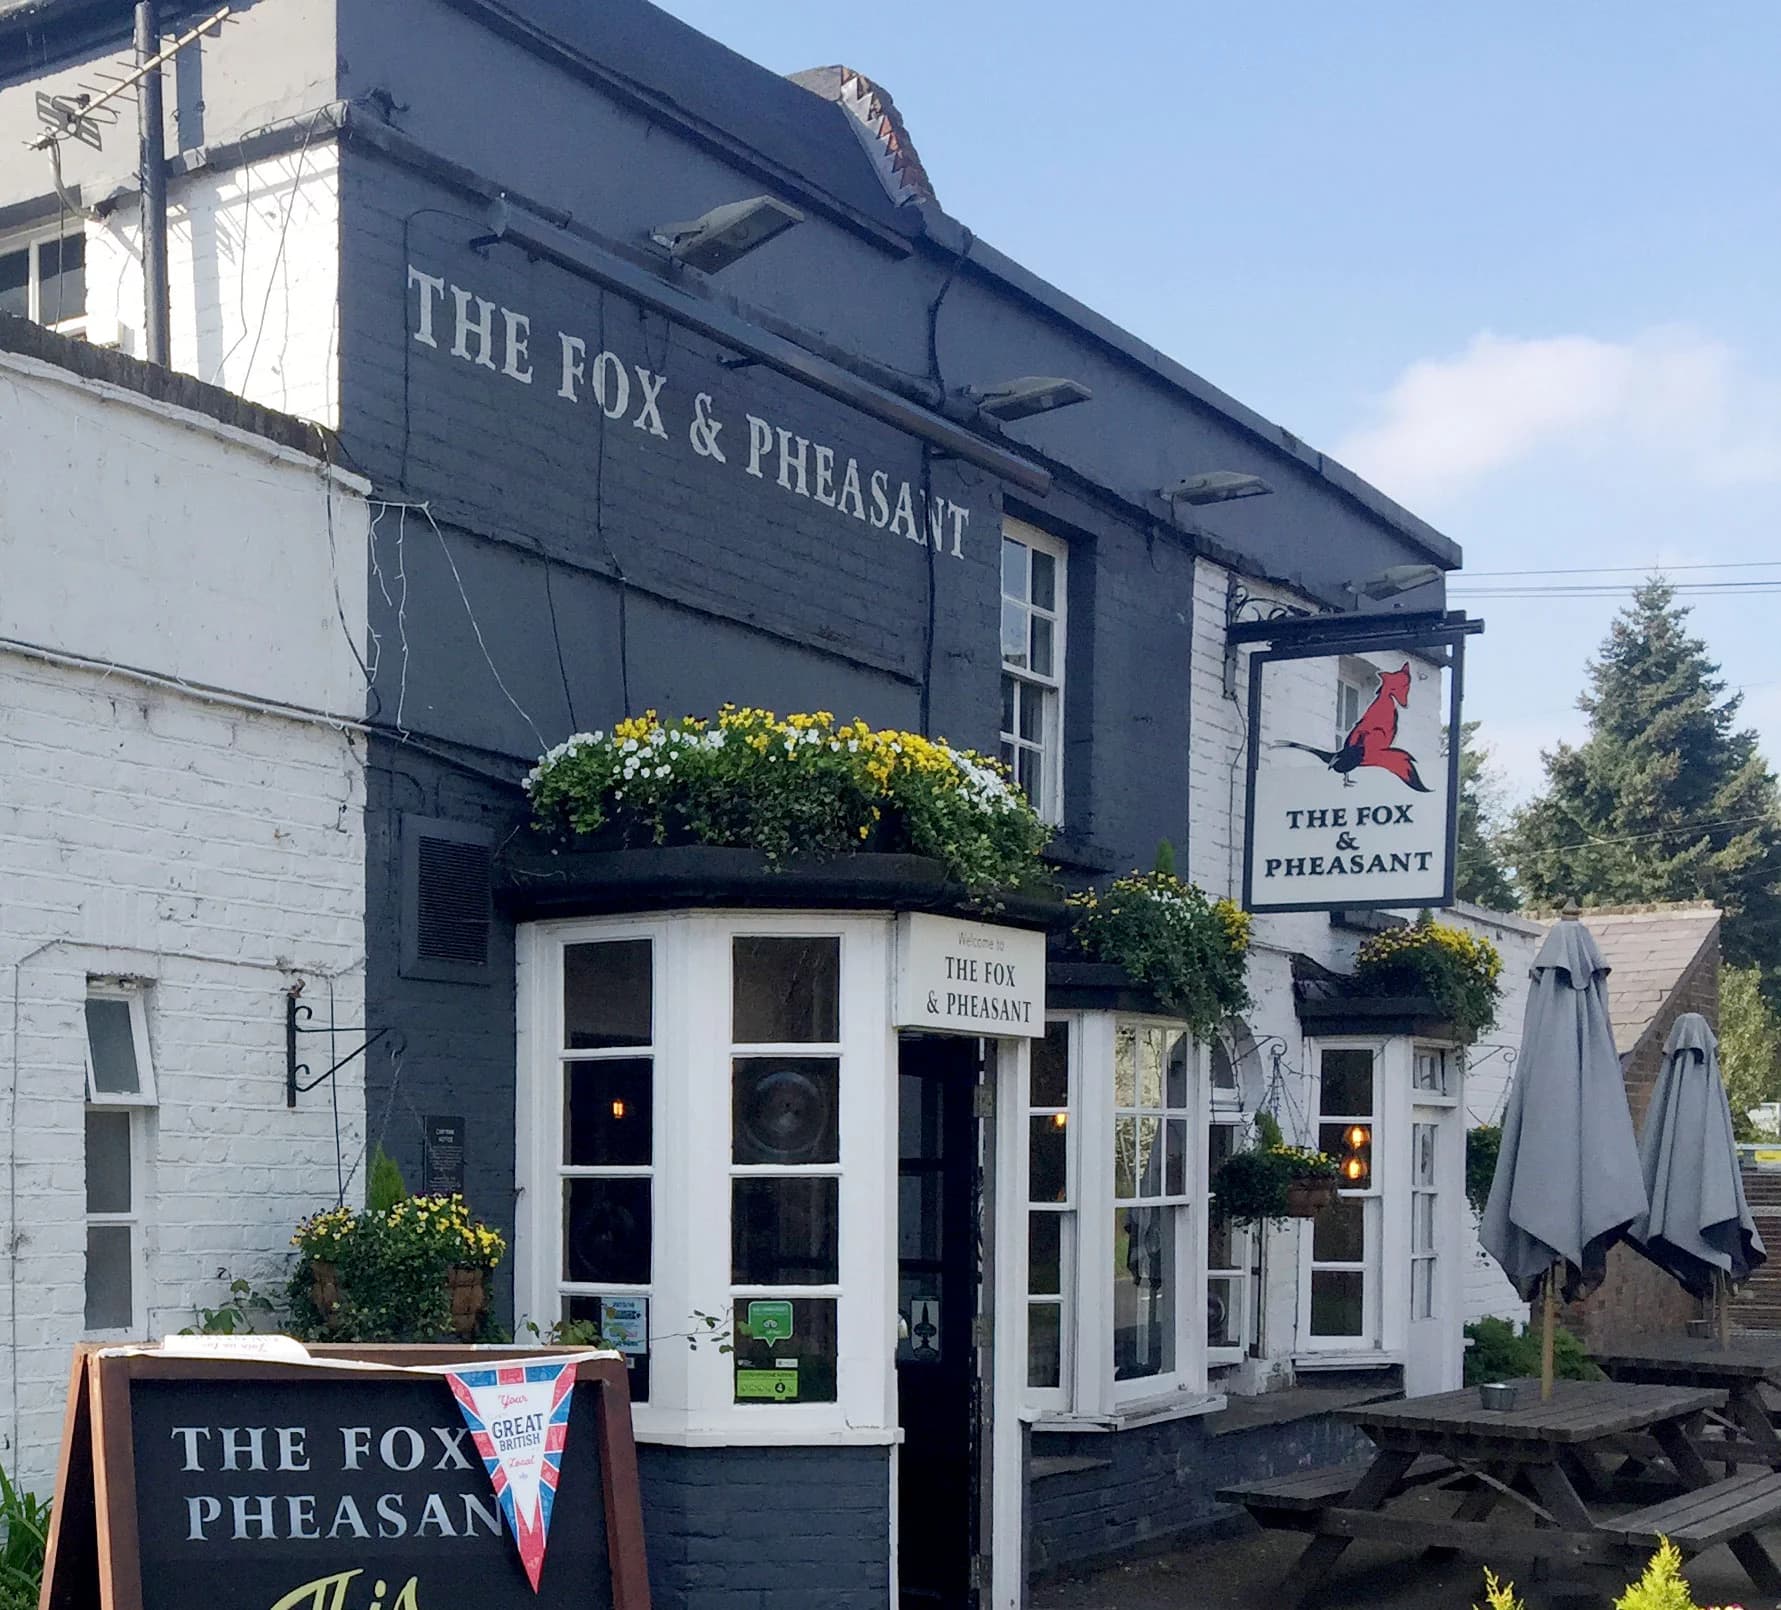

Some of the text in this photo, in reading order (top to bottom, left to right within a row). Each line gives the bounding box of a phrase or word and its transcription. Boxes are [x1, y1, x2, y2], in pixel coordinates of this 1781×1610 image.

[407, 263, 970, 560] THE FOX & PHEASANT
[1286, 804, 1414, 829] THE FOX
[1335, 831, 1360, 851] &
[1264, 851, 1433, 878] PHEASANT
[958, 931, 1005, 952] Welcome to
[945, 956, 1016, 988] THE FOX
[926, 989, 1032, 1023] & PHEASANT
[498, 1394, 528, 1409] Your
[491, 1413, 544, 1439] GREAT
[171, 1426, 474, 1472] THE FOX
[499, 1432, 540, 1452] BRITISH
[509, 1455, 535, 1469] Local
[184, 1492, 504, 1541] PHEASAN
